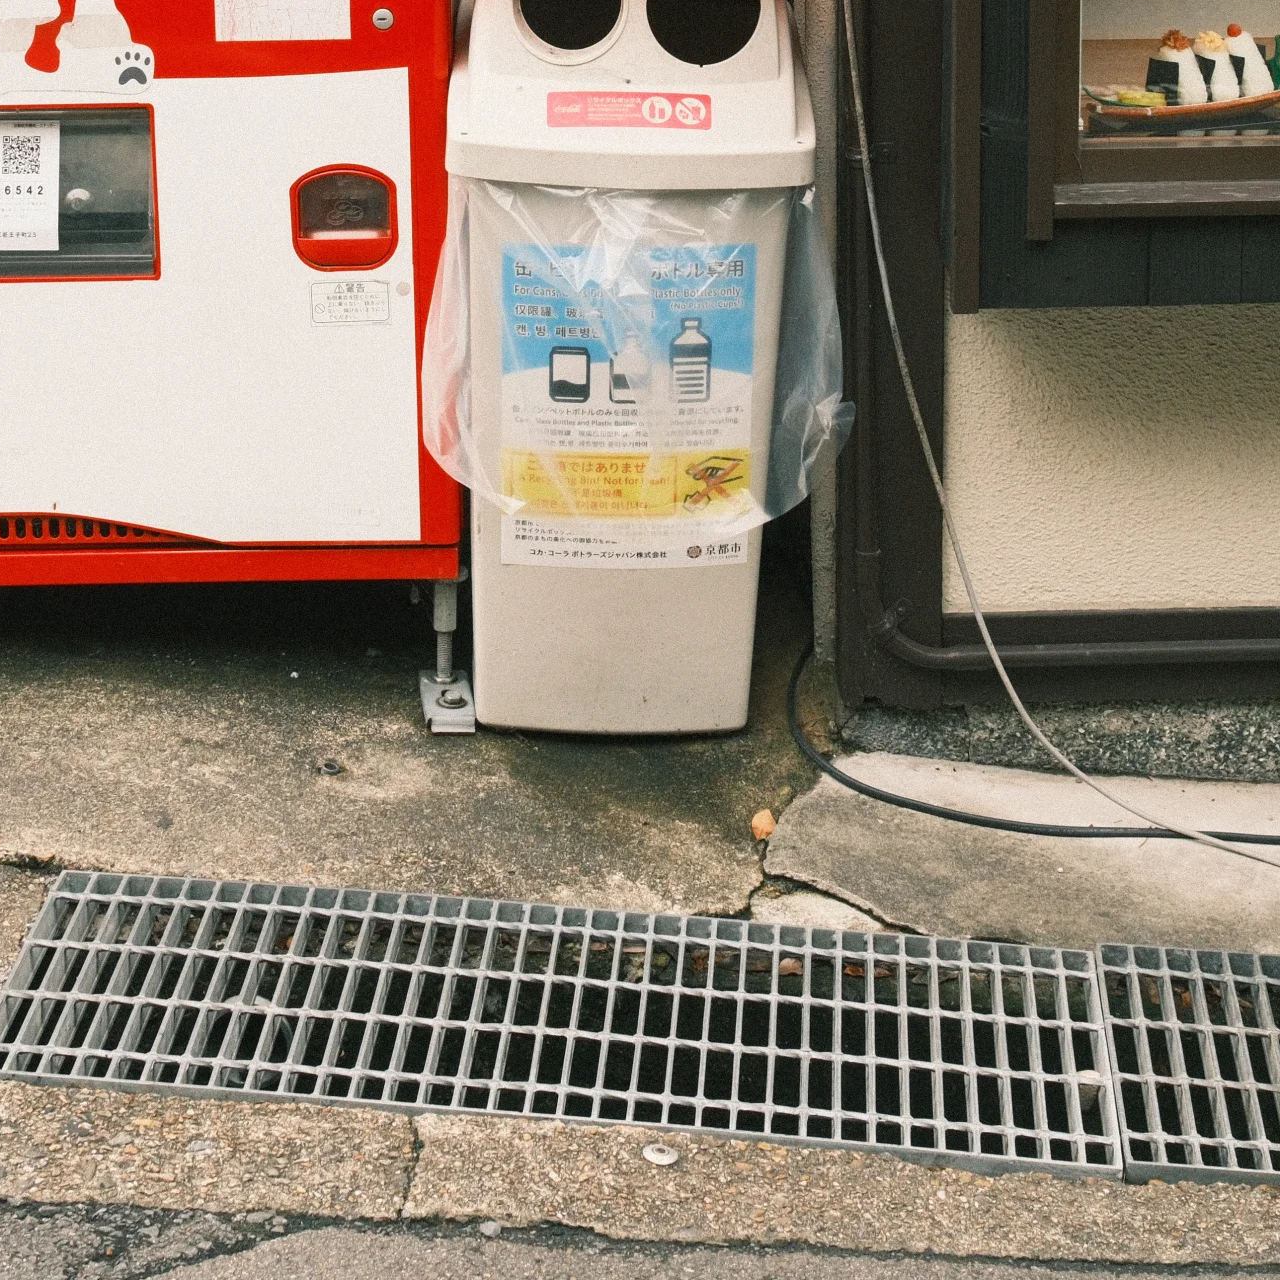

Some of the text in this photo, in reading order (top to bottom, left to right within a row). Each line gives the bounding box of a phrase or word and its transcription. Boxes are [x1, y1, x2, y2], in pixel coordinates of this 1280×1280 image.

[587, 97, 642, 105] リサイクルボックス
[515, 261, 532, 277] 缶
[345, 282, 365, 293] 警告
[514, 285, 559, 298] For Cans,
[603, 477, 622, 485] Not
[624, 477, 638, 485] for
[529, 548, 668, 559] コカ・コーラ ボトラーズジャパン株式会社
[705, 541, 742, 556] 京都市
